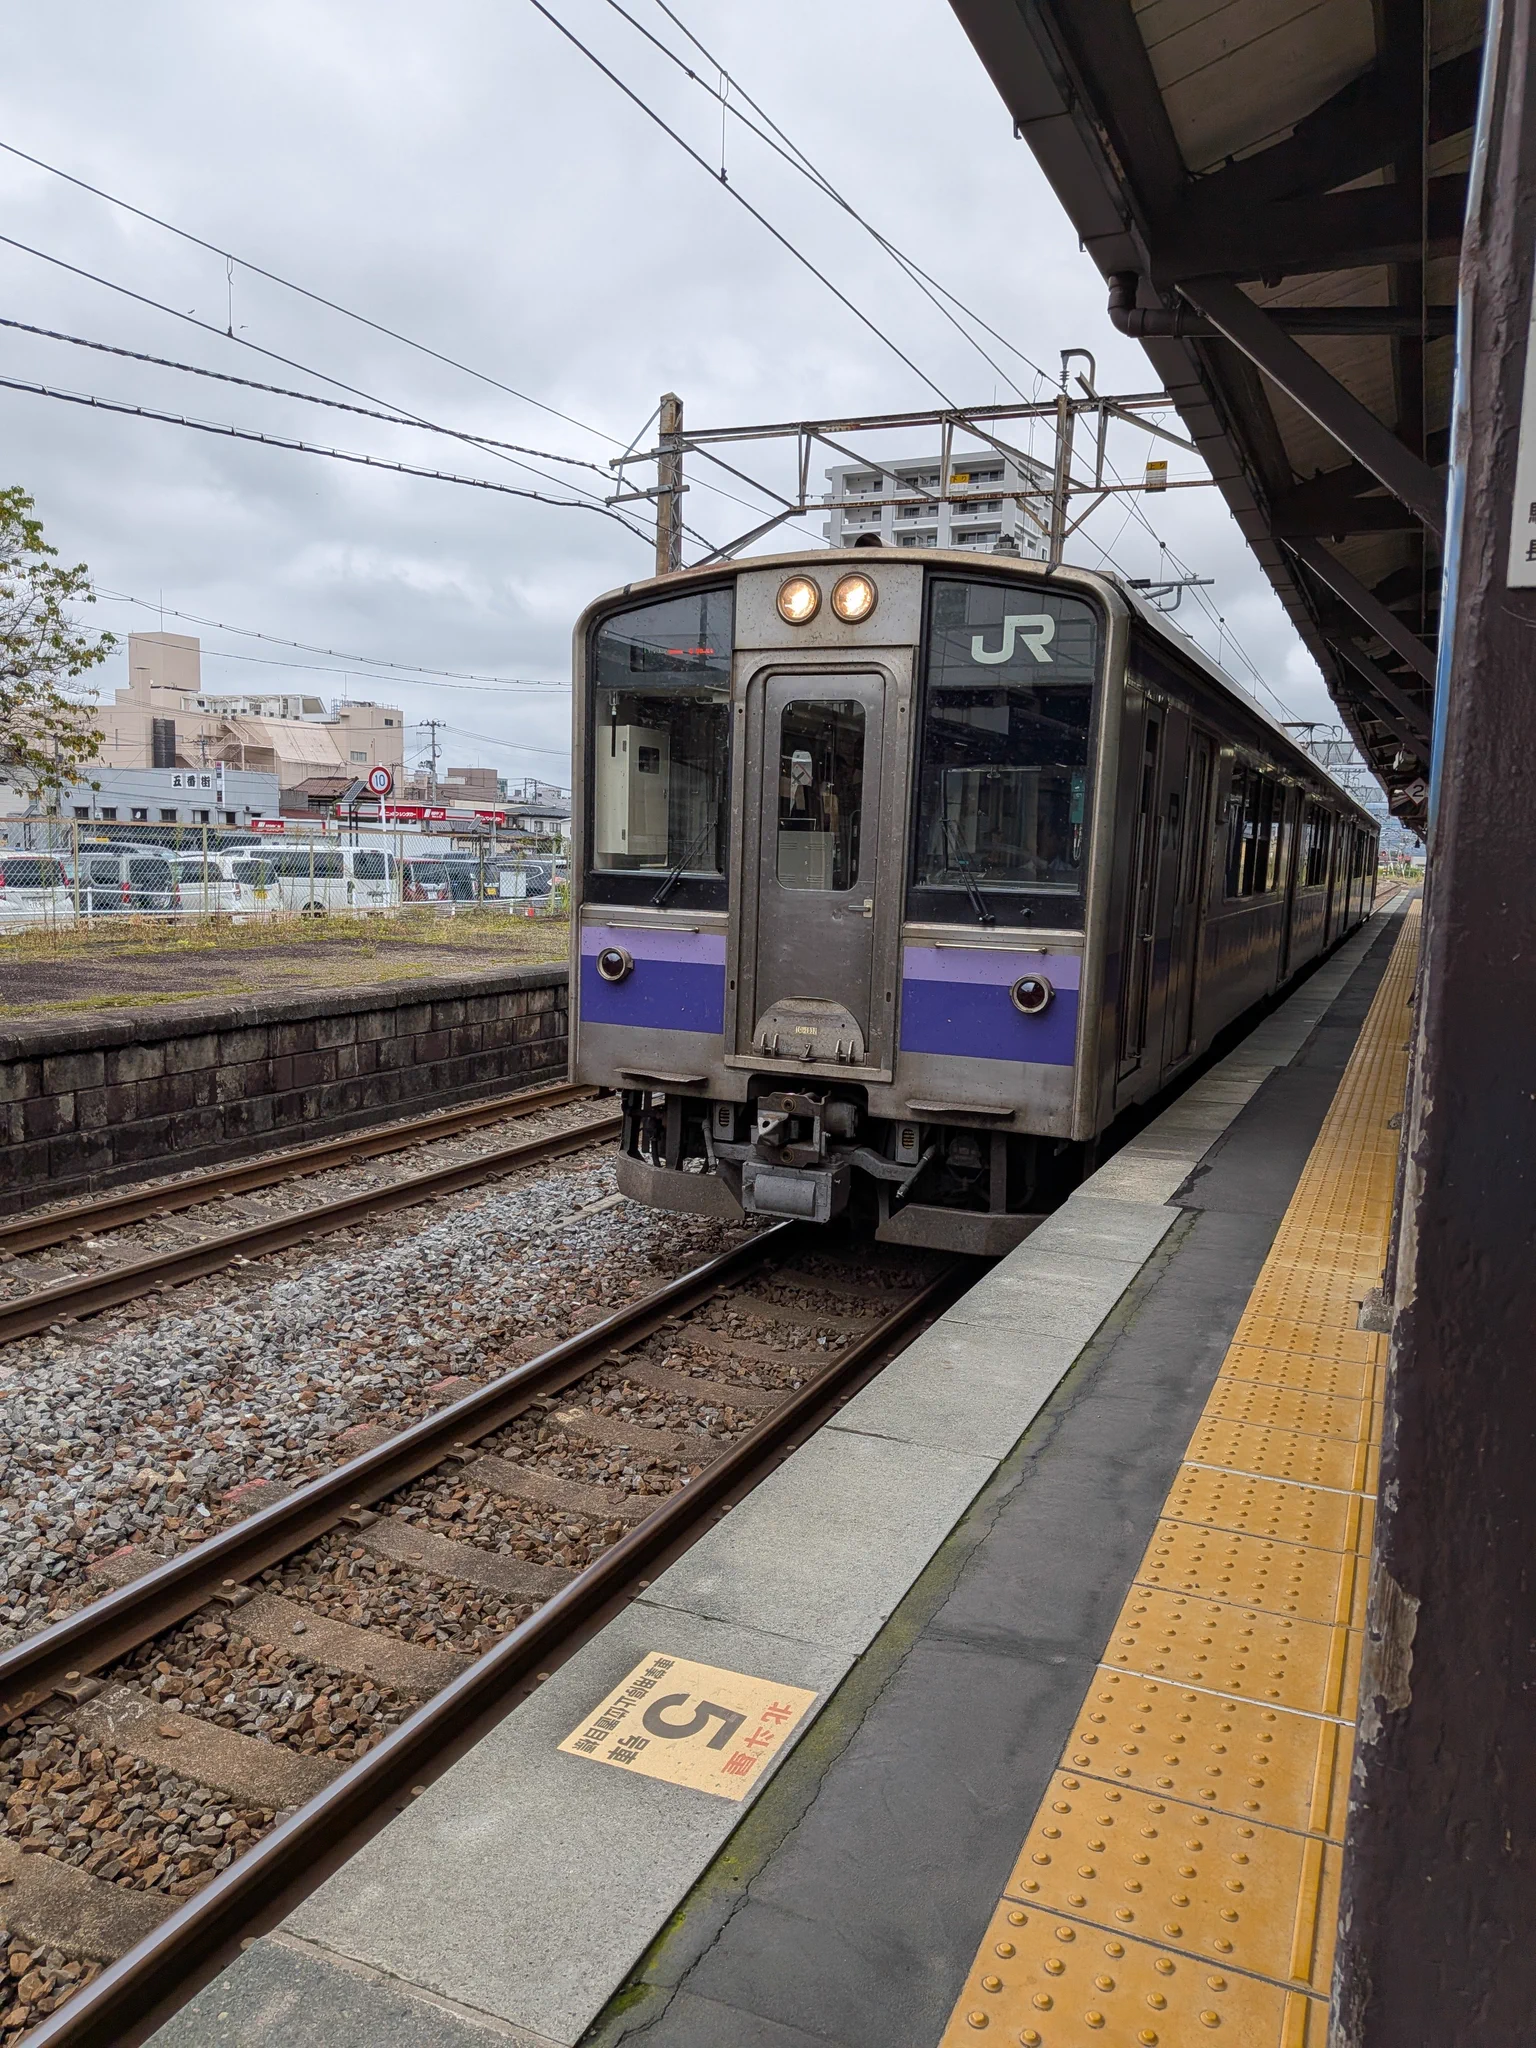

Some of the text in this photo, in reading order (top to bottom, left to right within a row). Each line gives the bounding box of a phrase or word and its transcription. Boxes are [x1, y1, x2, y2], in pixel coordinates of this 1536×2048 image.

[971, 614, 1055, 664] JR
[173, 775, 211, 788] 五番街
[375, 774, 386, 787] 10
[1412, 784, 1425, 797] 2
[721, 1701, 793, 1776] 北斗星
